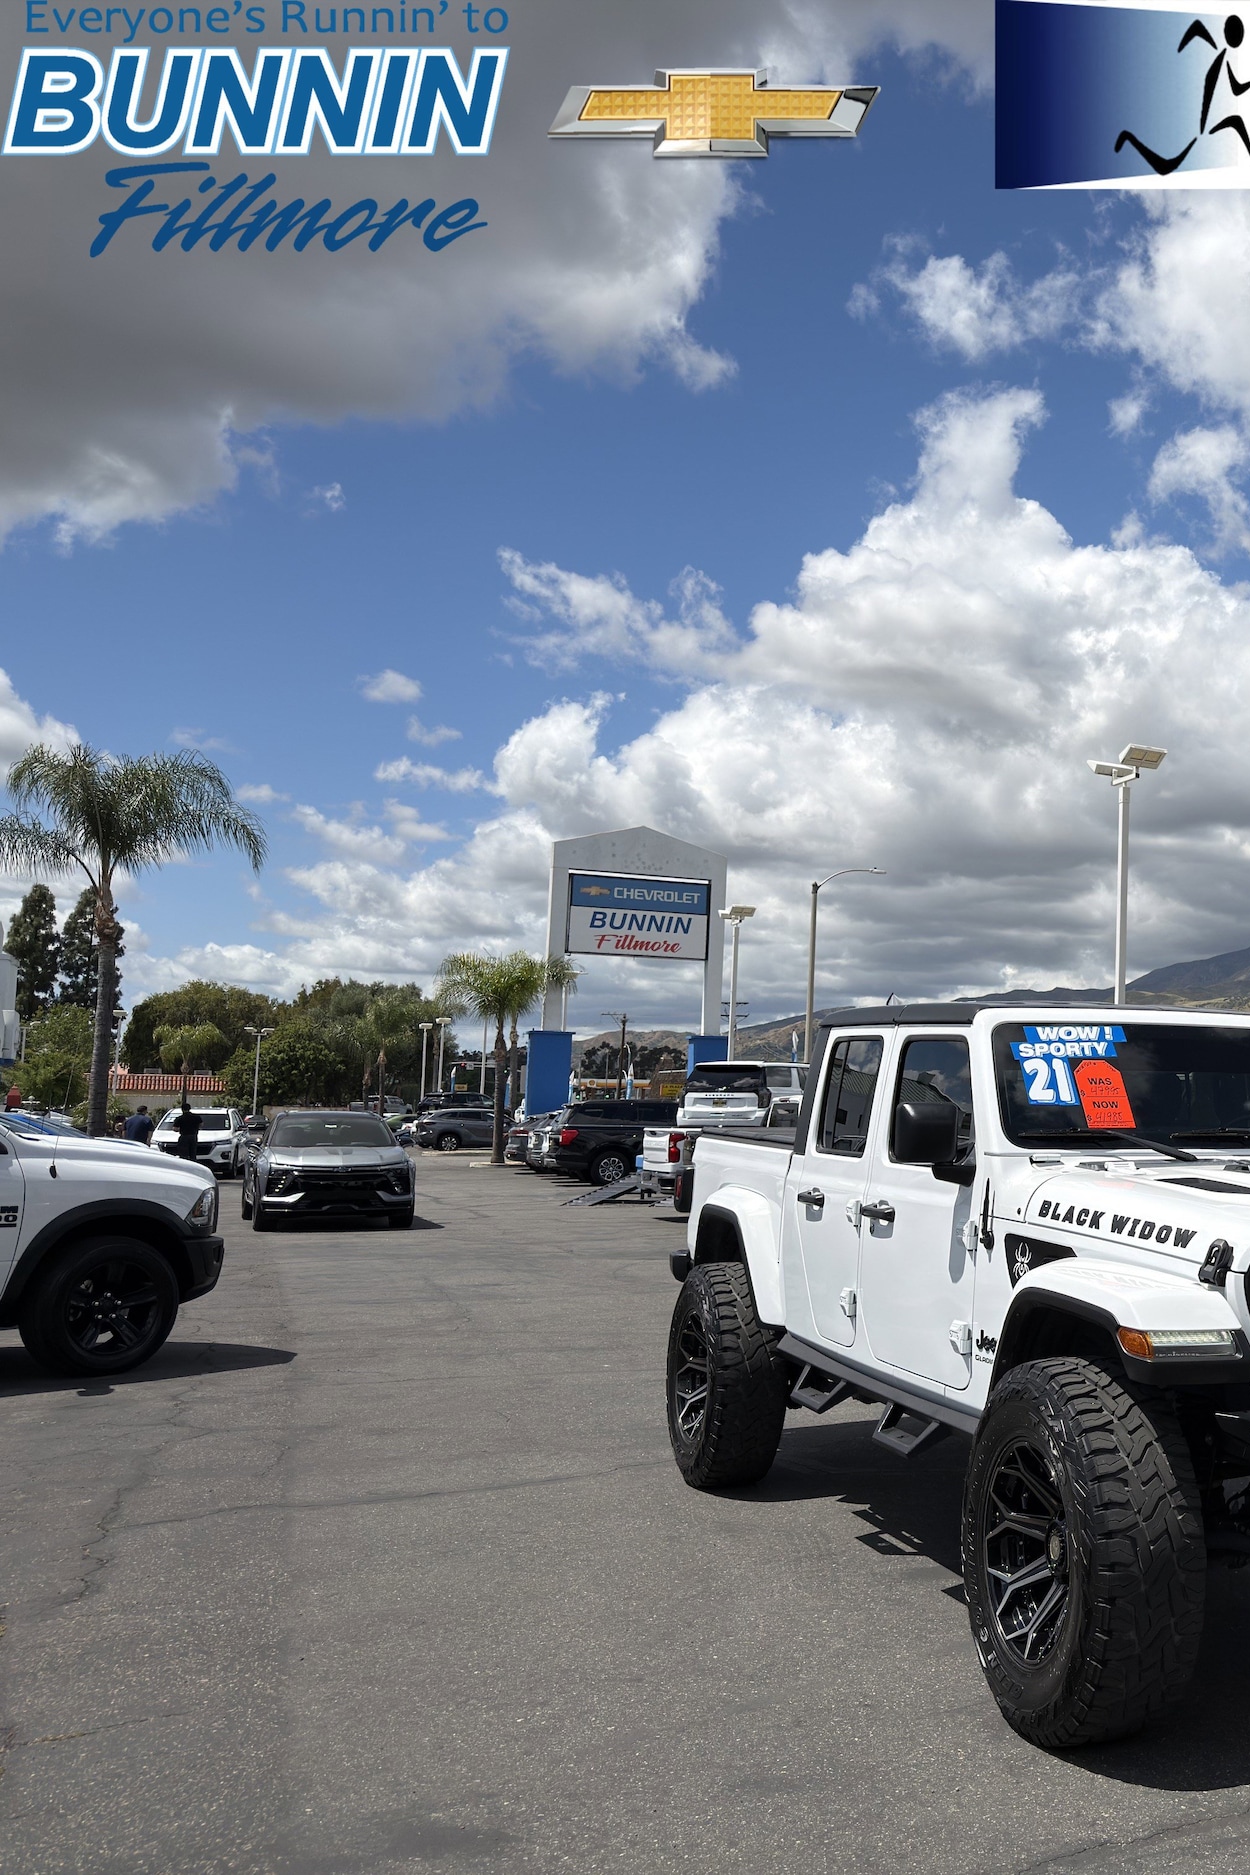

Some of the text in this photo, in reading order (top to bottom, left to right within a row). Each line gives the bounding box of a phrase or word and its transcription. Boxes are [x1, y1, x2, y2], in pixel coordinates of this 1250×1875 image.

[614, 887, 700, 904] CHEVROLET
[589, 911, 693, 934] BUNNIN
[594, 934, 682, 954] Fillmore
[1019, 1042, 1108, 1057] SPORTY
[1023, 1058, 1076, 1103] 21
[1038, 1200, 1198, 1249] BLACK WIDOW
